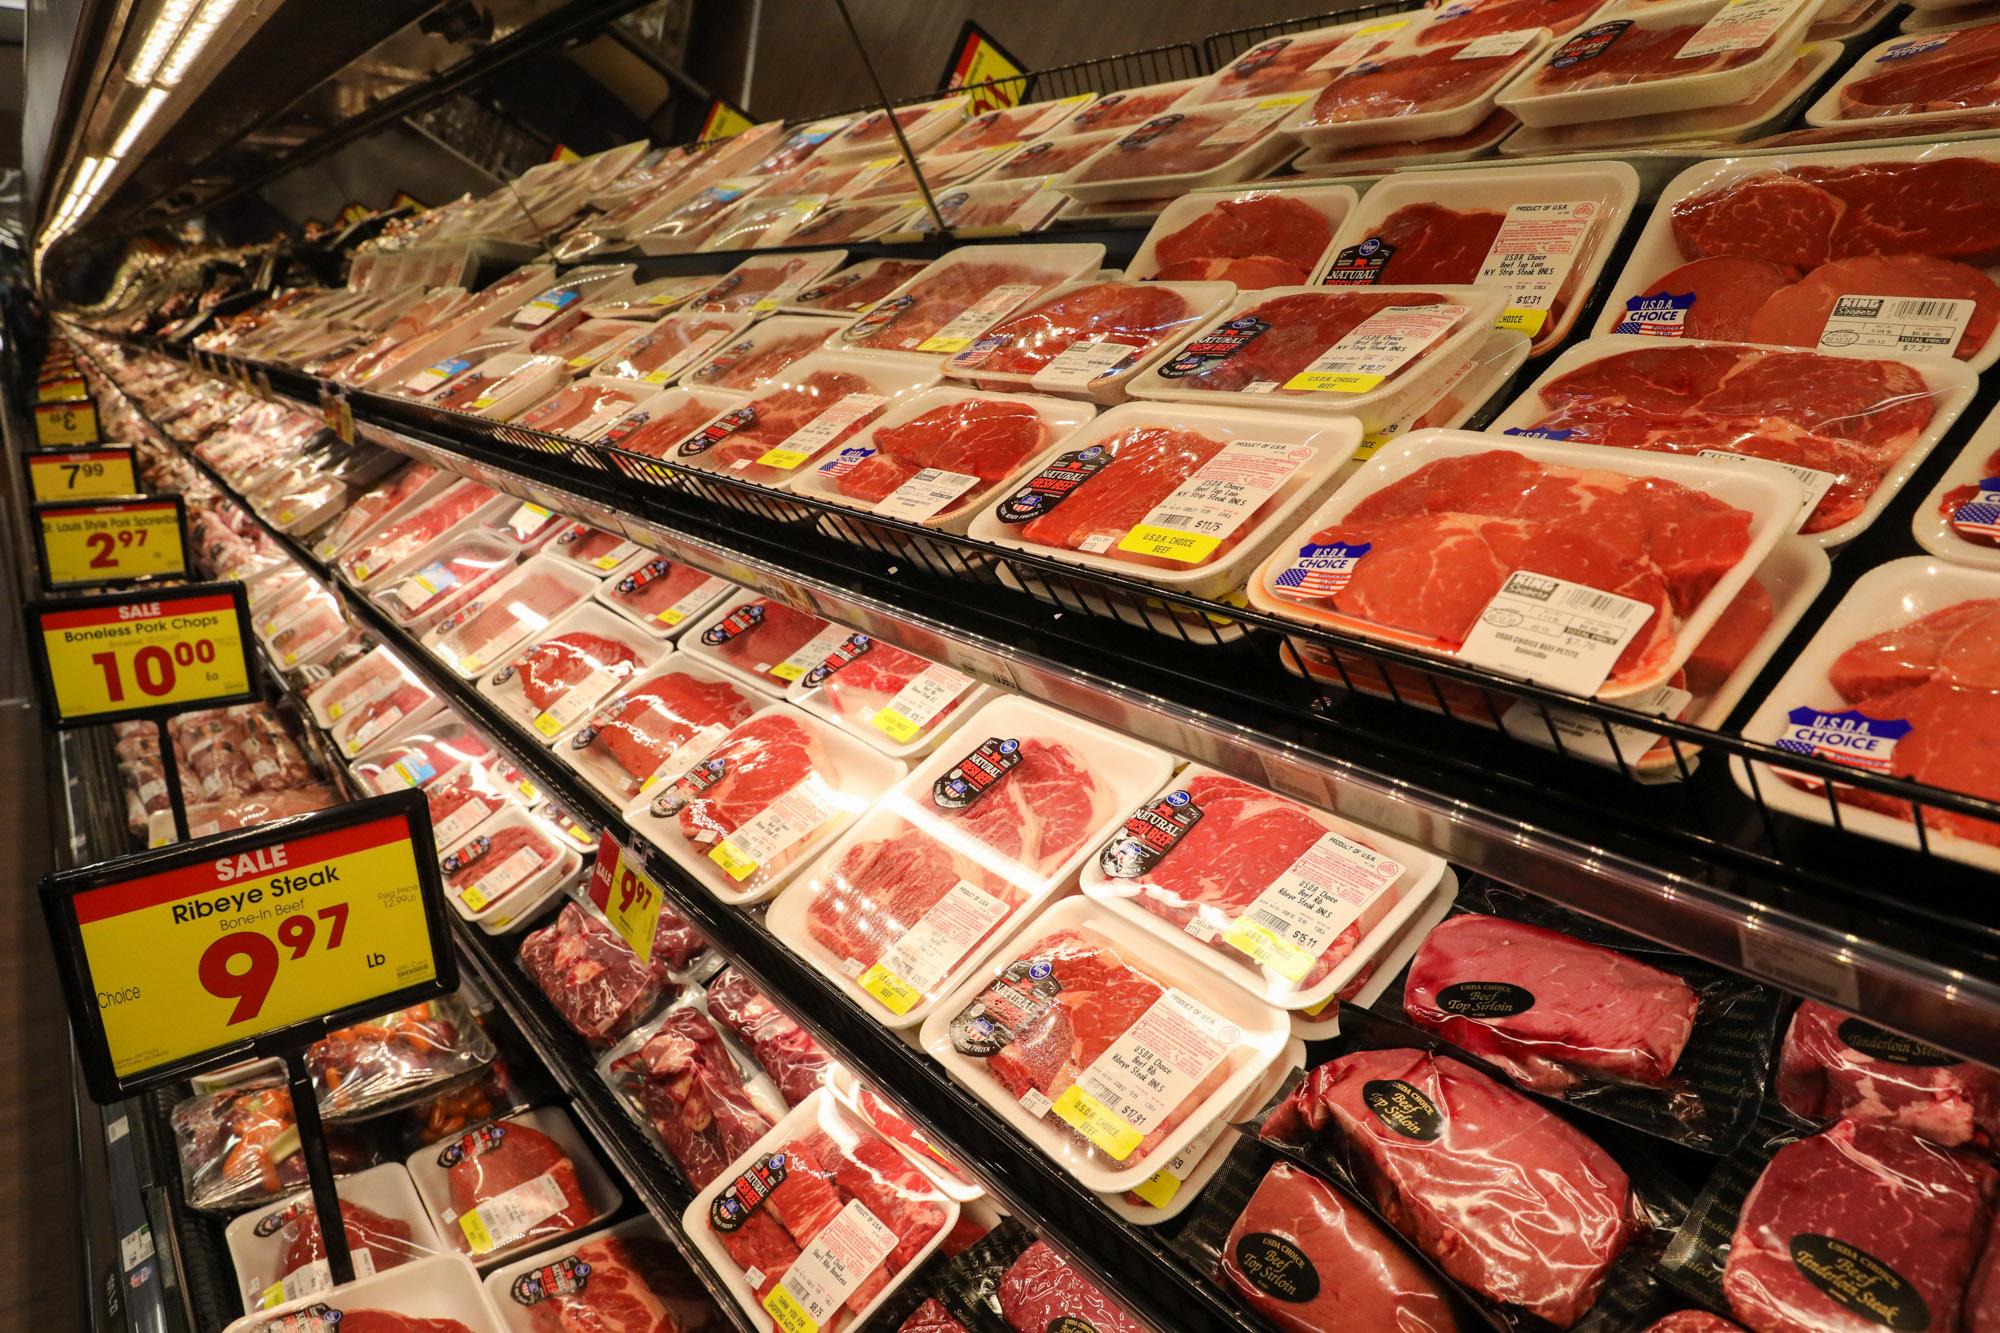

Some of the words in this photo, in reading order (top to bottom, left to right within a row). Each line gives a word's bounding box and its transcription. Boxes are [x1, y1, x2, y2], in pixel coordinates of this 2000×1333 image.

[1327, 269, 1375, 280] NATURAL
[1499, 268, 1514, 276] Strip
[1517, 268, 1535, 276] Steak
[1517, 262, 1529, 270] Top
[1840, 298, 1881, 308] KING
[1630, 310, 1679, 321] CHOICE
[1900, 336, 1924, 344] TOTAL
[1926, 337, 1949, 345] PRICE
[1902, 344, 1933, 353] $7.27
[1333, 376, 1361, 384] CHOICE
[1235, 441, 1261, 449] PRODUCT
[1039, 470, 1086, 482] NATURAL
[1224, 481, 1246, 490] Choice
[57, 520, 82, 533] Louis
[110, 517, 131, 528] Pork
[1152, 544, 1173, 554] BEEF
[1168, 535, 1196, 548] CHOICE
[1298, 558, 1350, 569] CHOICE
[118, 602, 161, 620] SALE
[64, 628, 132, 643] Boneless
[135, 620, 168, 634] Pork
[171, 615, 219, 631] Chops
[1513, 635, 1540, 648] CHOICE
[1539, 642, 1556, 653] BEEF
[205, 671, 220, 682] Ea
[1795, 728, 1880, 752] CHOICE
[959, 759, 980, 778] FRESH
[974, 769, 995, 786] BEEF
[969, 752, 1002, 778] NATURAL
[1132, 808, 1179, 837] NATURAL
[1147, 826, 1175, 847] BEEF
[1329, 836, 1353, 852] PRODUCT
[1351, 846, 1361, 855] OF
[215, 843, 288, 882] SALE
[596, 862, 613, 887] SALE
[171, 888, 263, 926] Ribeye
[270, 865, 340, 898] Steak
[1277, 887, 1299, 901] Ribeye
[1299, 897, 1315, 911] Steak
[1297, 889, 1312, 900] Beef
[1319, 889, 1338, 904] Choice
[219, 908, 272, 932] Bone-In
[274, 898, 305, 917] Beef
[366, 951, 386, 969] Lb
[97, 986, 141, 1009] Choice
[991, 980, 1034, 1012] NATURAL
[1470, 990, 1500, 1003] Beef
[1483, 984, 1512, 993] CHOICE
[1192, 1006, 1201, 1015] OF
[1448, 999, 1471, 1013] Top
[1471, 1000, 1513, 1012] Sirloin
[1848, 1034, 1912, 1053] Tenderloin
[1111, 1052, 1131, 1070] Ribeye
[1130, 1065, 1148, 1083] Steak
[1131, 1055, 1146, 1070] Beef
[1153, 1057, 1173, 1075] Choice
[1391, 1092, 1423, 1114] Beef
[1410, 1092, 1434, 1116] CHOICE
[1369, 1092, 1389, 1108] Top
[1384, 1106, 1421, 1134] Sirloin
[1080, 1121, 1098, 1138] BEEF
[1095, 1114, 1120, 1138] CHOICE
[744, 1168, 768, 1198] NATURAL
[825, 1249, 835, 1261] Beef
[832, 1257, 846, 1272] Chuck
[1262, 1237, 1281, 1249] USDA
[1280, 1245, 1306, 1269] CHOICE
[1264, 1249, 1294, 1273] Beef
[812, 1248, 824, 1262] Short
[829, 1267, 847, 1287] Boneless
[1243, 1253, 1263, 1275] Top
[1260, 1266, 1297, 1296] Sirloin
[1827, 1240, 1858, 1260] USDA
[1860, 1257, 1902, 1290] CHOICE
[1835, 1257, 1882, 1288] Beef
[1796, 1250, 1860, 1297] Tenderloin
[1856, 1291, 1900, 1326] Steak
[767, 1300, 786, 1322] SHOPPING
[777, 1295, 791, 1312] THANK
[789, 1308, 799, 1321] YOU
